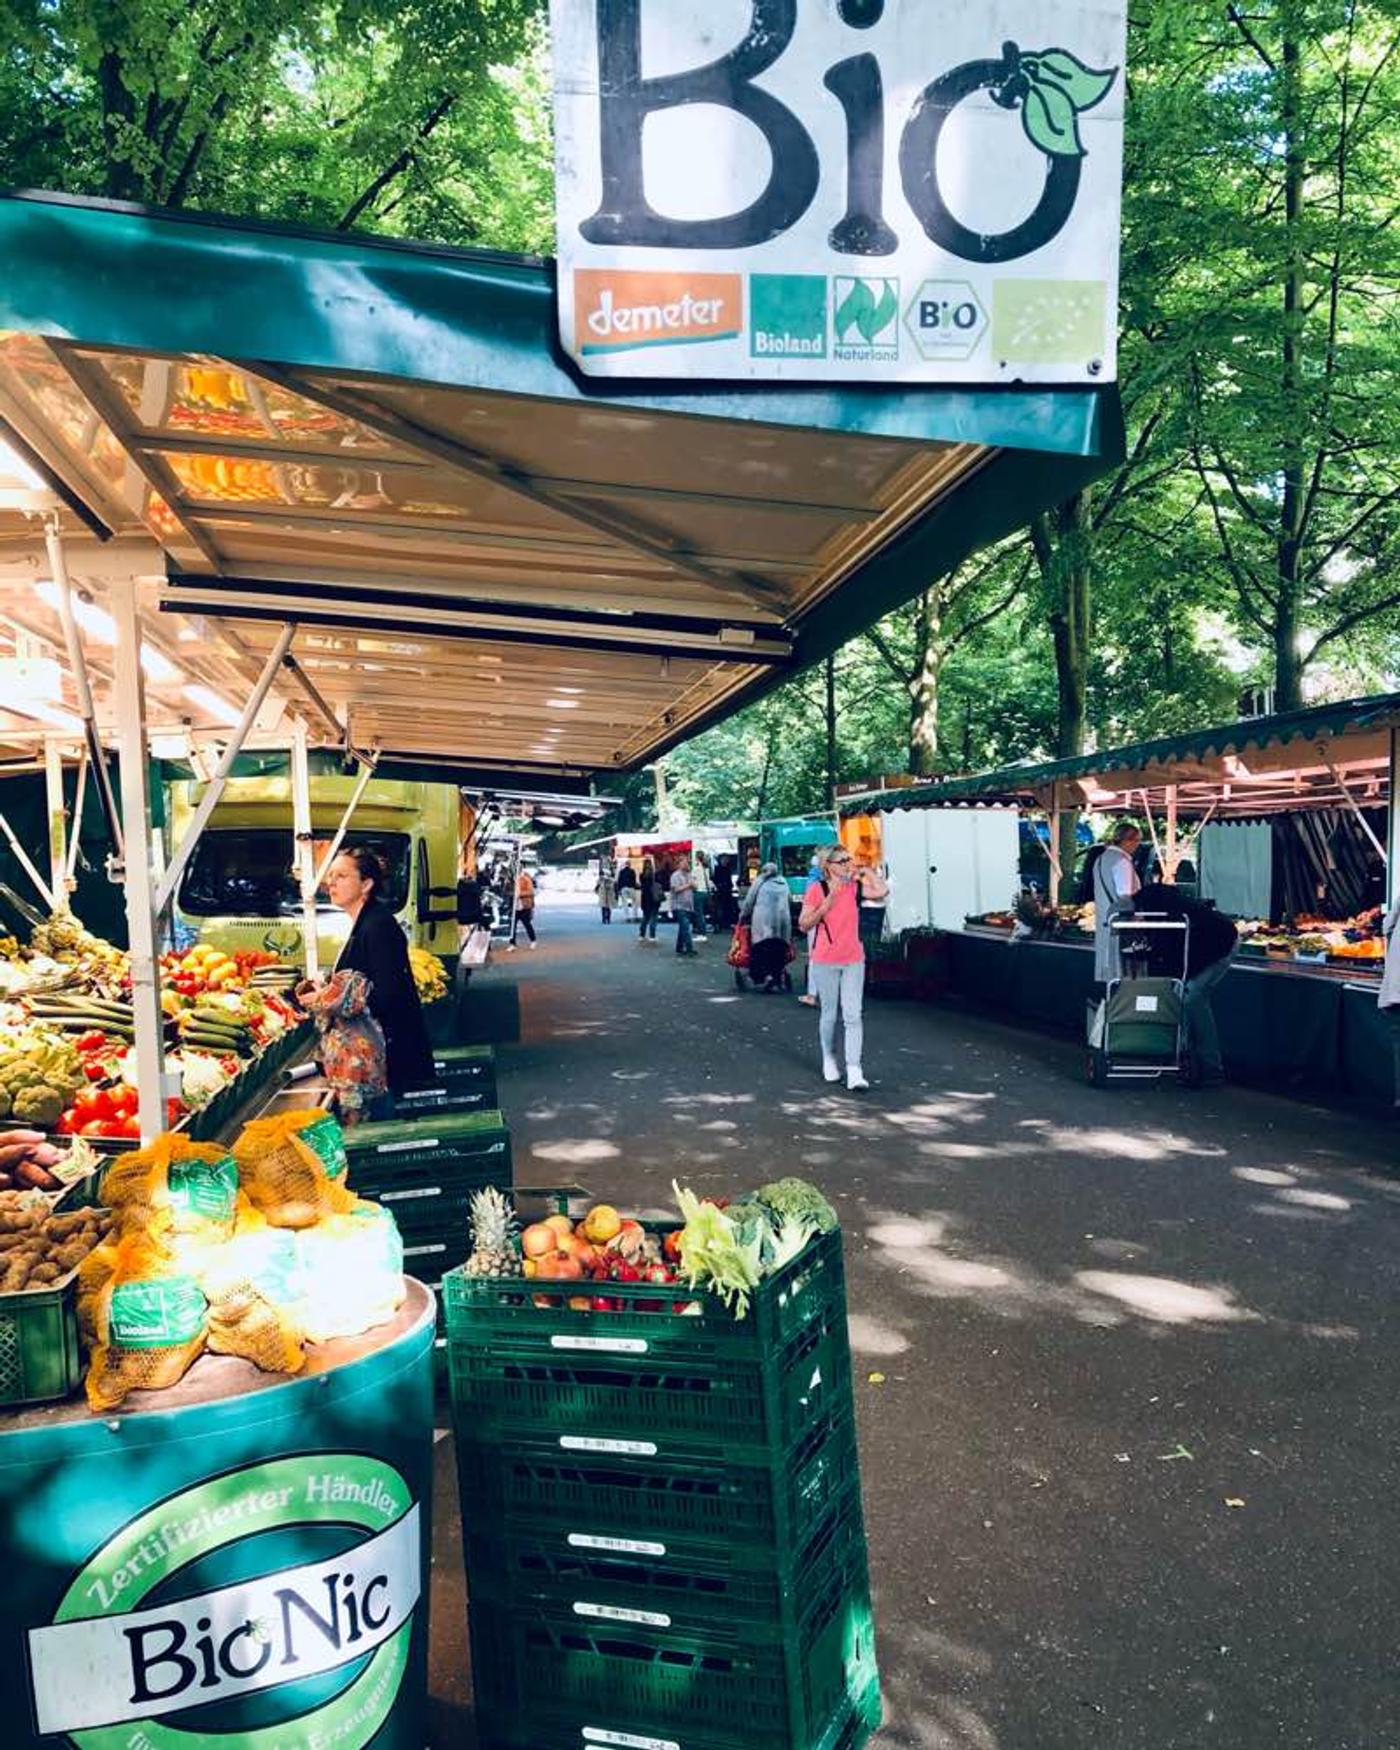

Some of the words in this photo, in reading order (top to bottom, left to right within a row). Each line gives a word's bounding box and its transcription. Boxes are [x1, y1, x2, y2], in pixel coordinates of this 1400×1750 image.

[578, 0, 1083, 263] Bio
[588, 289, 724, 336] demeter
[755, 331, 824, 354] Bioland
[833, 348, 899, 362] Naturland
[87, 1485, 293, 1610] Zertifizierter
[306, 1474, 398, 1517] Händler
